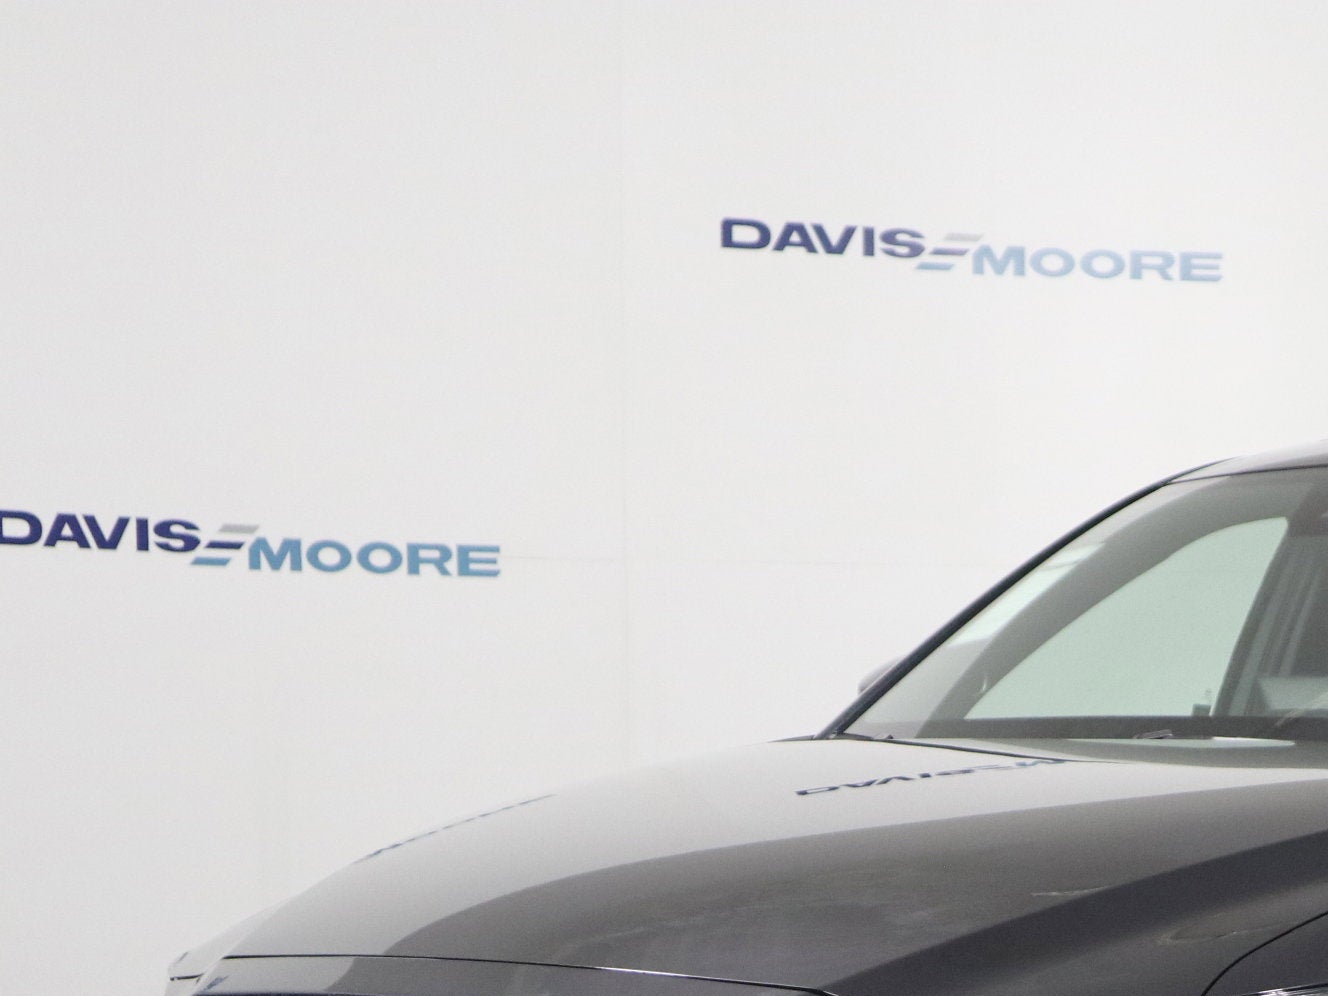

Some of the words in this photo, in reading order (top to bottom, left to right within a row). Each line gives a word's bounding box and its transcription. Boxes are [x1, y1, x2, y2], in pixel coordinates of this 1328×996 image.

[720, 216, 925, 257] DAVIS
[973, 244, 1222, 282] MOORE
[0, 508, 201, 553] DAVIS
[247, 535, 501, 578] MOORE
